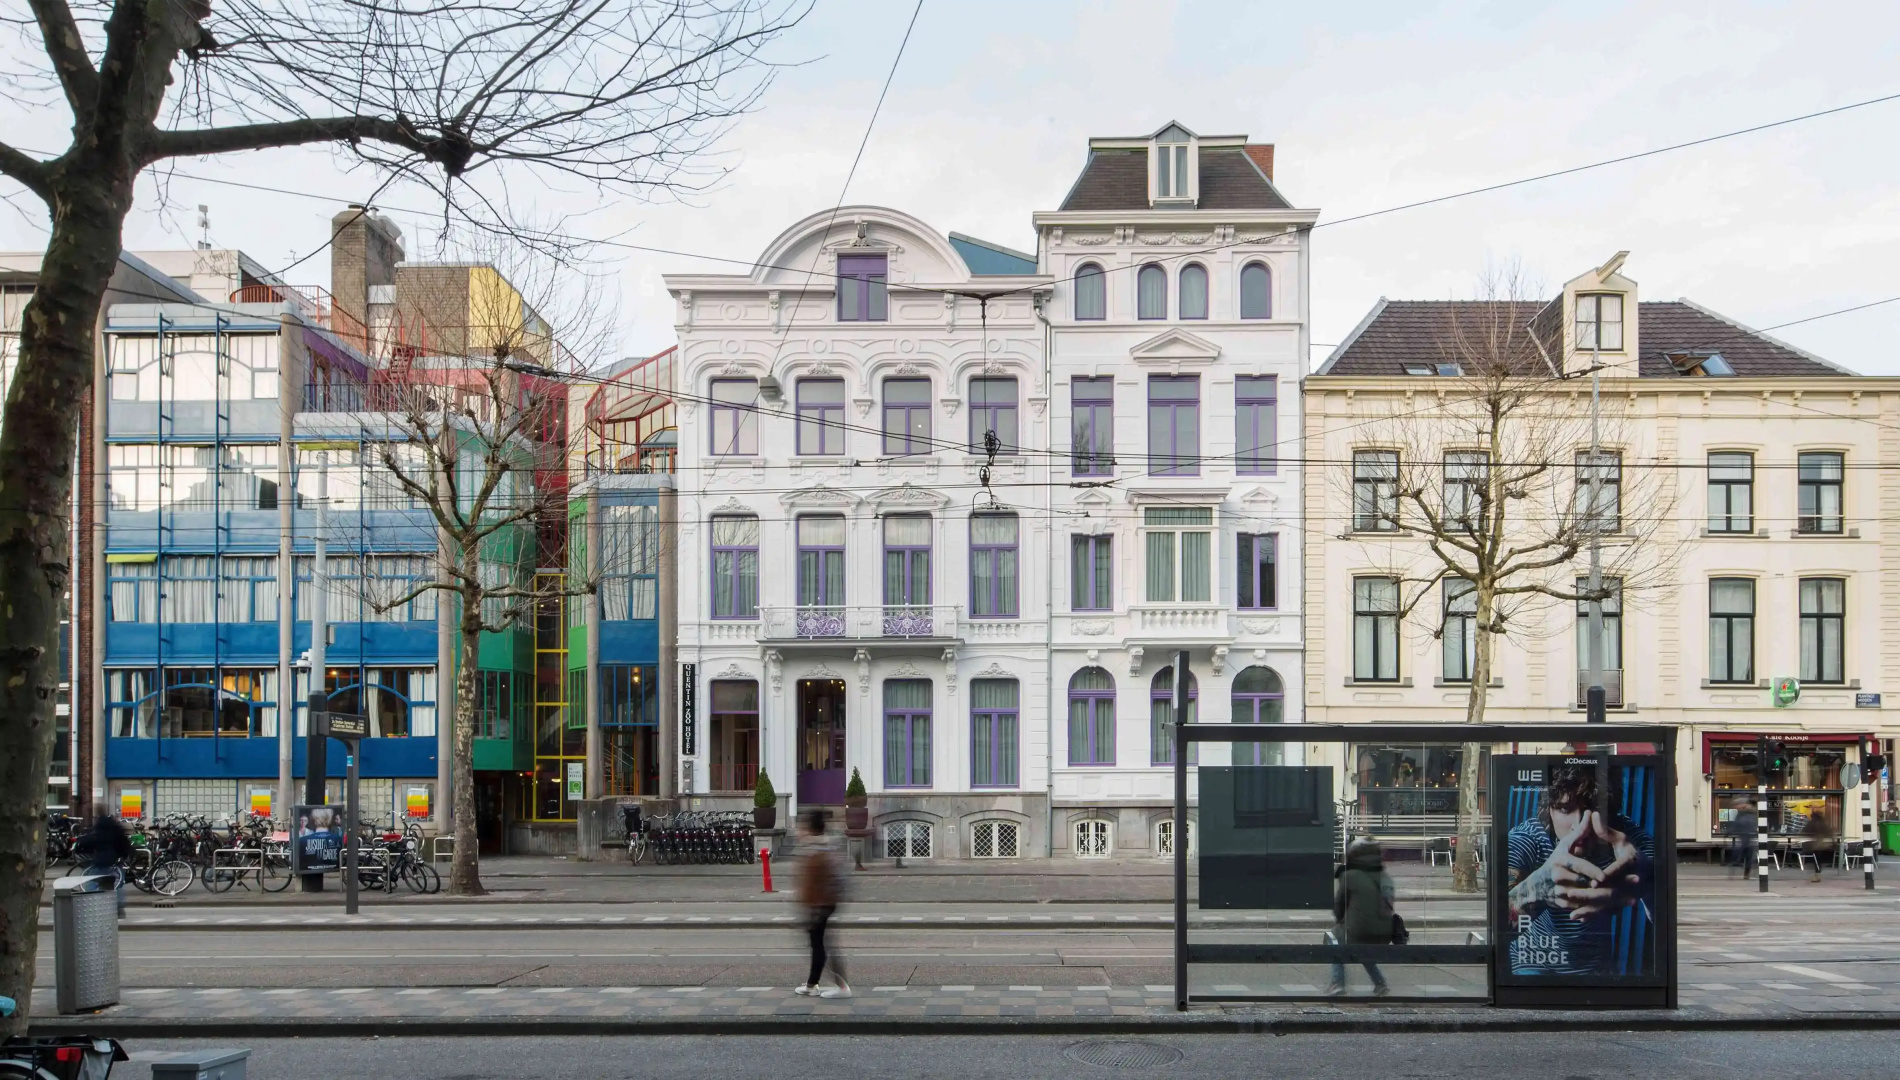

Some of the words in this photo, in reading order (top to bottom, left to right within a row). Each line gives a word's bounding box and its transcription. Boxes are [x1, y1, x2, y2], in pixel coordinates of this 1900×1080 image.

[1564, 757, 1598, 765] JCDecaux
[1517, 769, 1543, 782] WE
[1518, 935, 1560, 949] BLUE
[1518, 950, 1569, 964] RIDGE
